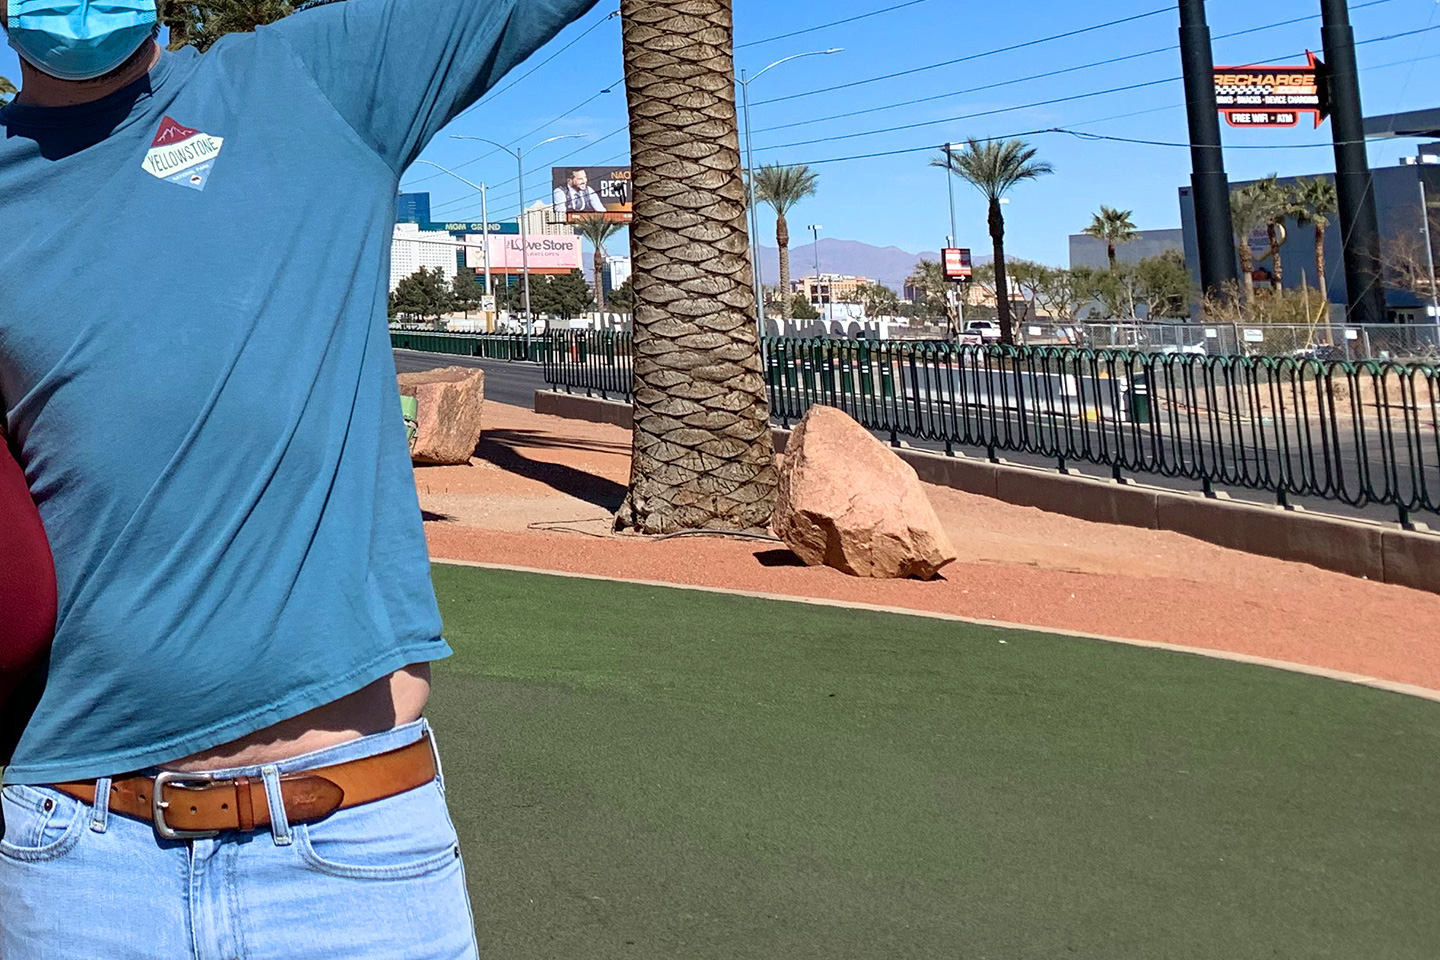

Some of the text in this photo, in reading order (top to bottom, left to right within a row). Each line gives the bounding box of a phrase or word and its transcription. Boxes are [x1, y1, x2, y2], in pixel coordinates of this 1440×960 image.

[1213, 74, 1316, 86] RECHARGE
[1237, 96, 1262, 104] SNACKS
[1265, 96, 1287, 104] DEVICE
[1288, 96, 1319, 104] CHARGING
[1232, 113, 1251, 123] FREE
[1277, 113, 1294, 123] ATM
[148, 137, 218, 173] YELLOWSTONE
[444, 223, 501, 231] MGM GRND
[542, 239, 573, 251] Store
